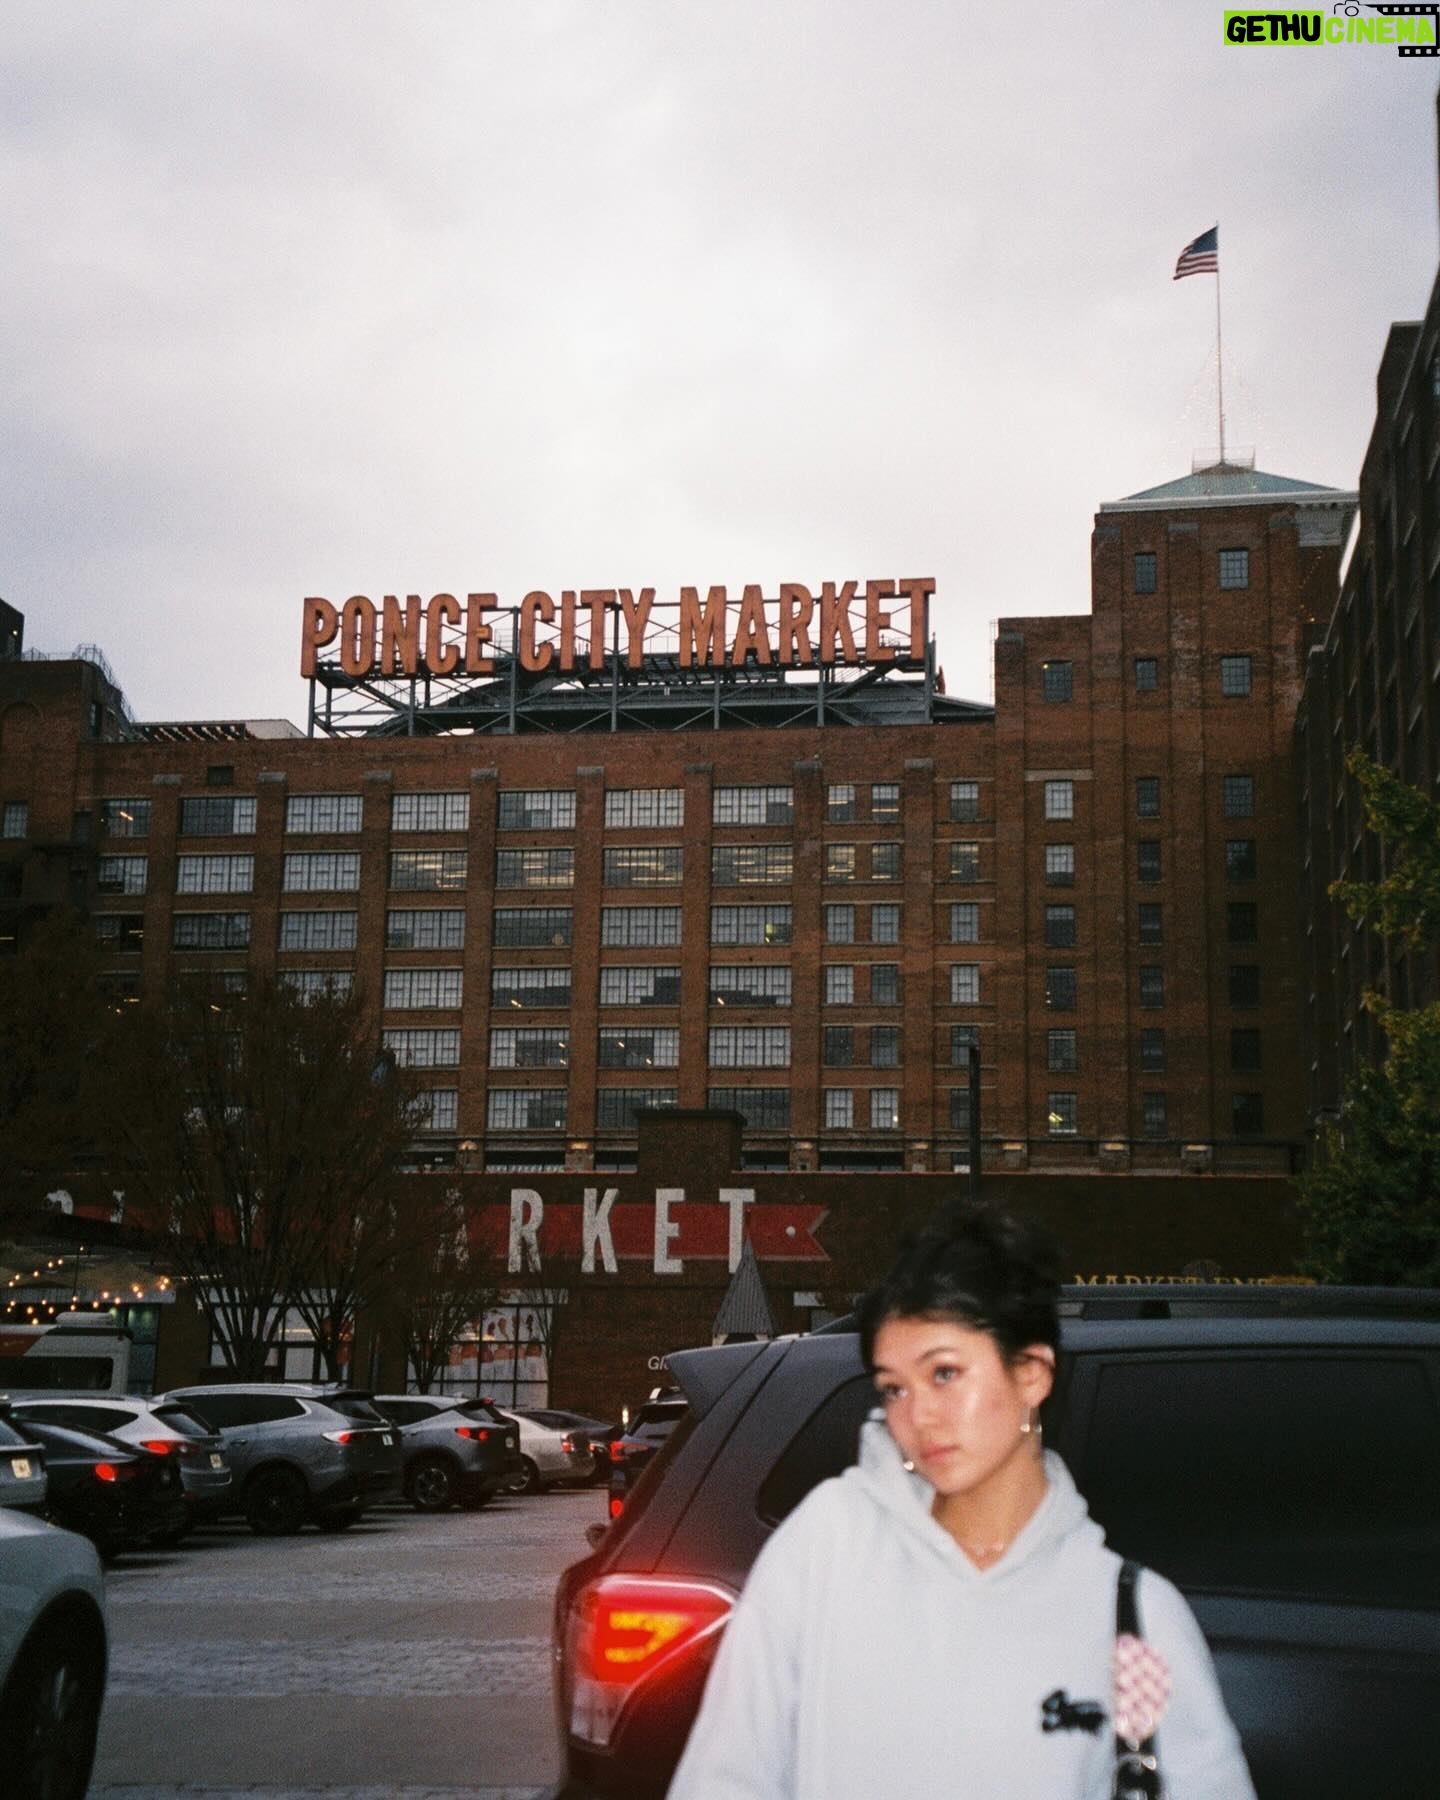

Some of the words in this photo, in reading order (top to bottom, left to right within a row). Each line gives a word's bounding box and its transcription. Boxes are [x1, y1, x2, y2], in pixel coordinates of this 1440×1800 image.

[301, 593, 497, 678] PONCE
[520, 587, 656, 672] CITY
[679, 577, 937, 668] MARKET
